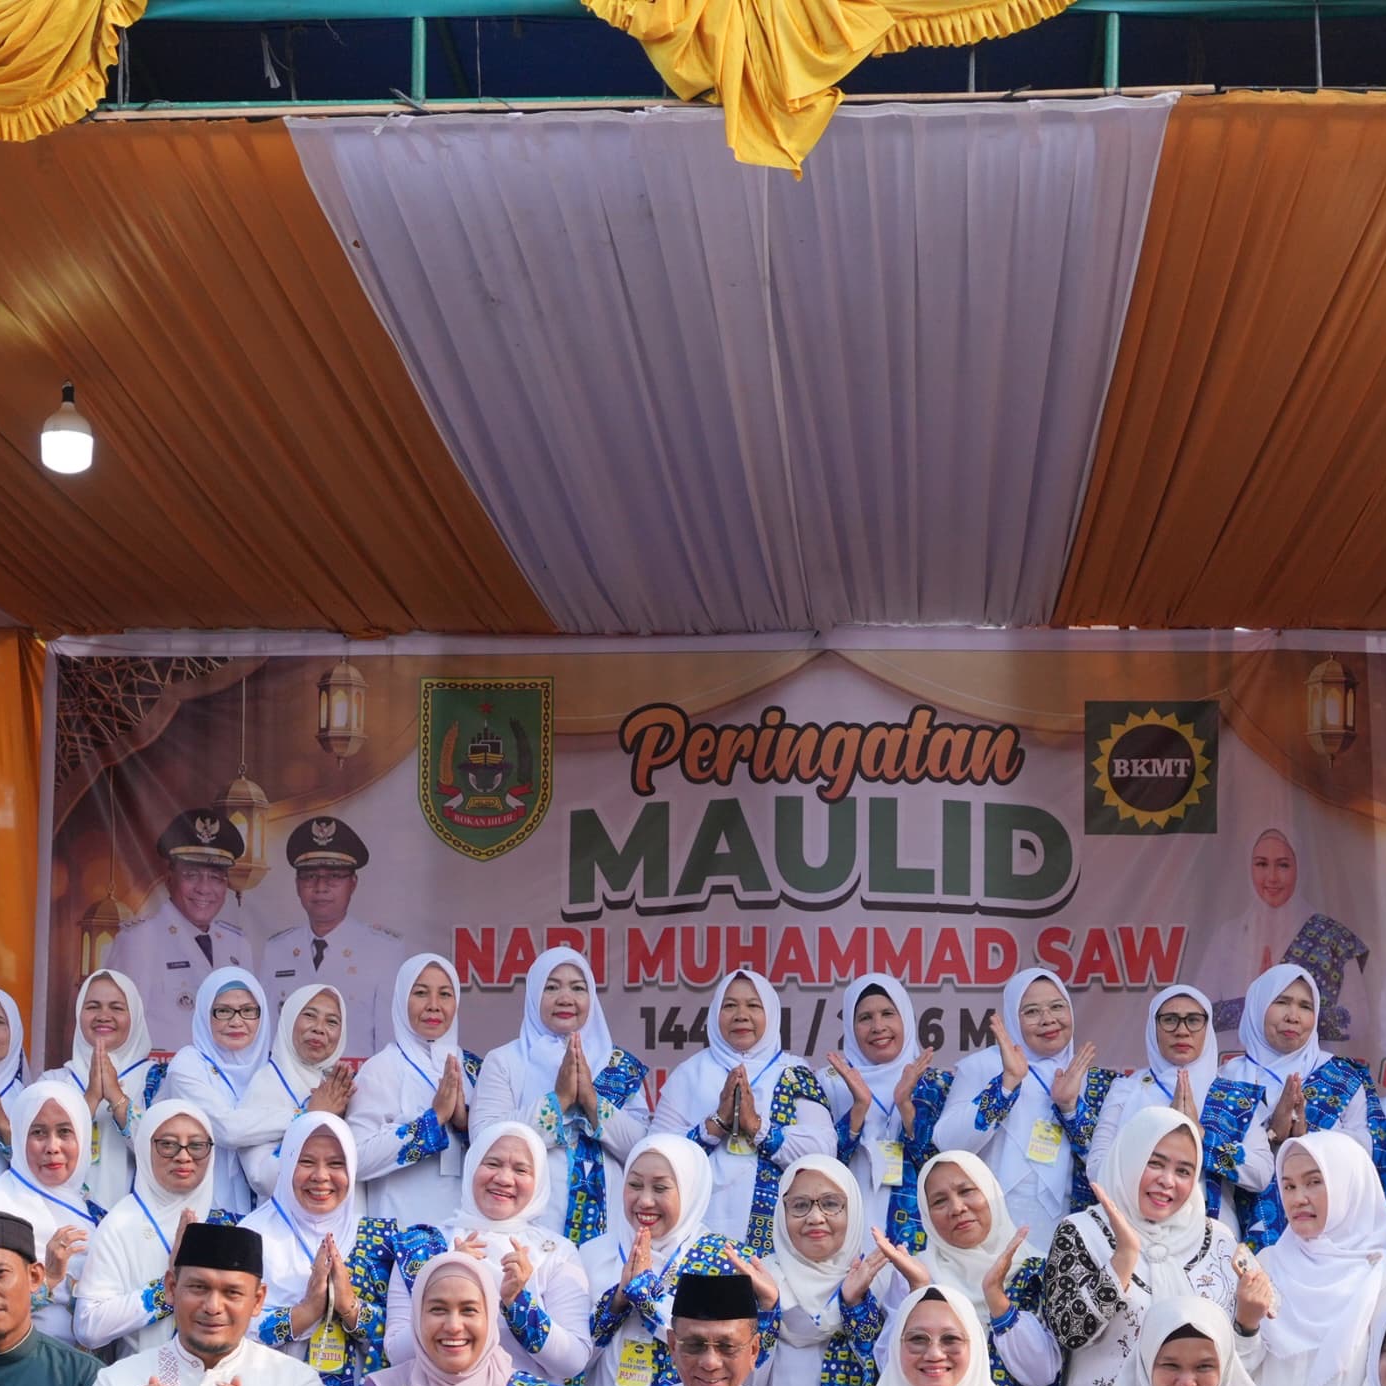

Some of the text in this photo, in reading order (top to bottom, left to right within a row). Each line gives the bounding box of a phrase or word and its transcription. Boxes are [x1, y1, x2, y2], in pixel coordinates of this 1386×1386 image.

[618, 702, 1025, 803] Peringatan
[1113, 758, 1191, 778] BKMT
[566, 796, 1077, 914] MAULID
[626, 925, 1020, 985] MUHAMMAD
[1035, 925, 1187, 985] SAW
